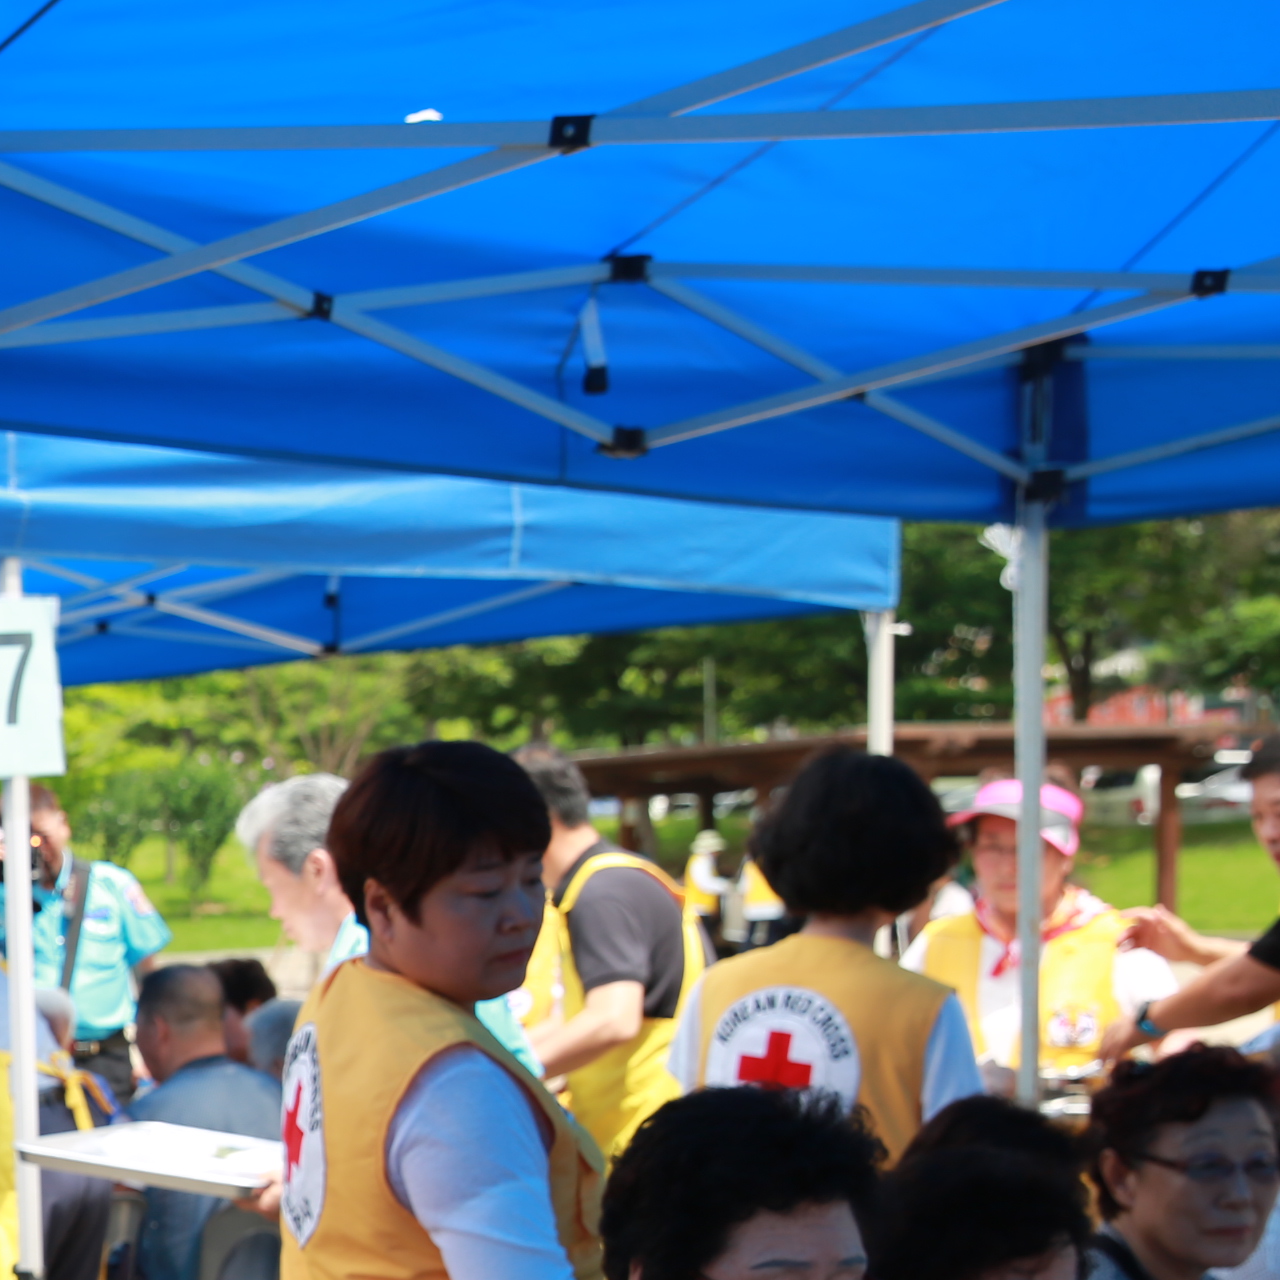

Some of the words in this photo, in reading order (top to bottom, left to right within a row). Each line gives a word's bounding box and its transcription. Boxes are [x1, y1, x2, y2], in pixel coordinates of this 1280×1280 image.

[717, 996, 776, 1043] KOREAN
[784, 995, 812, 1014] RED
[813, 1007, 850, 1060] CROSS
